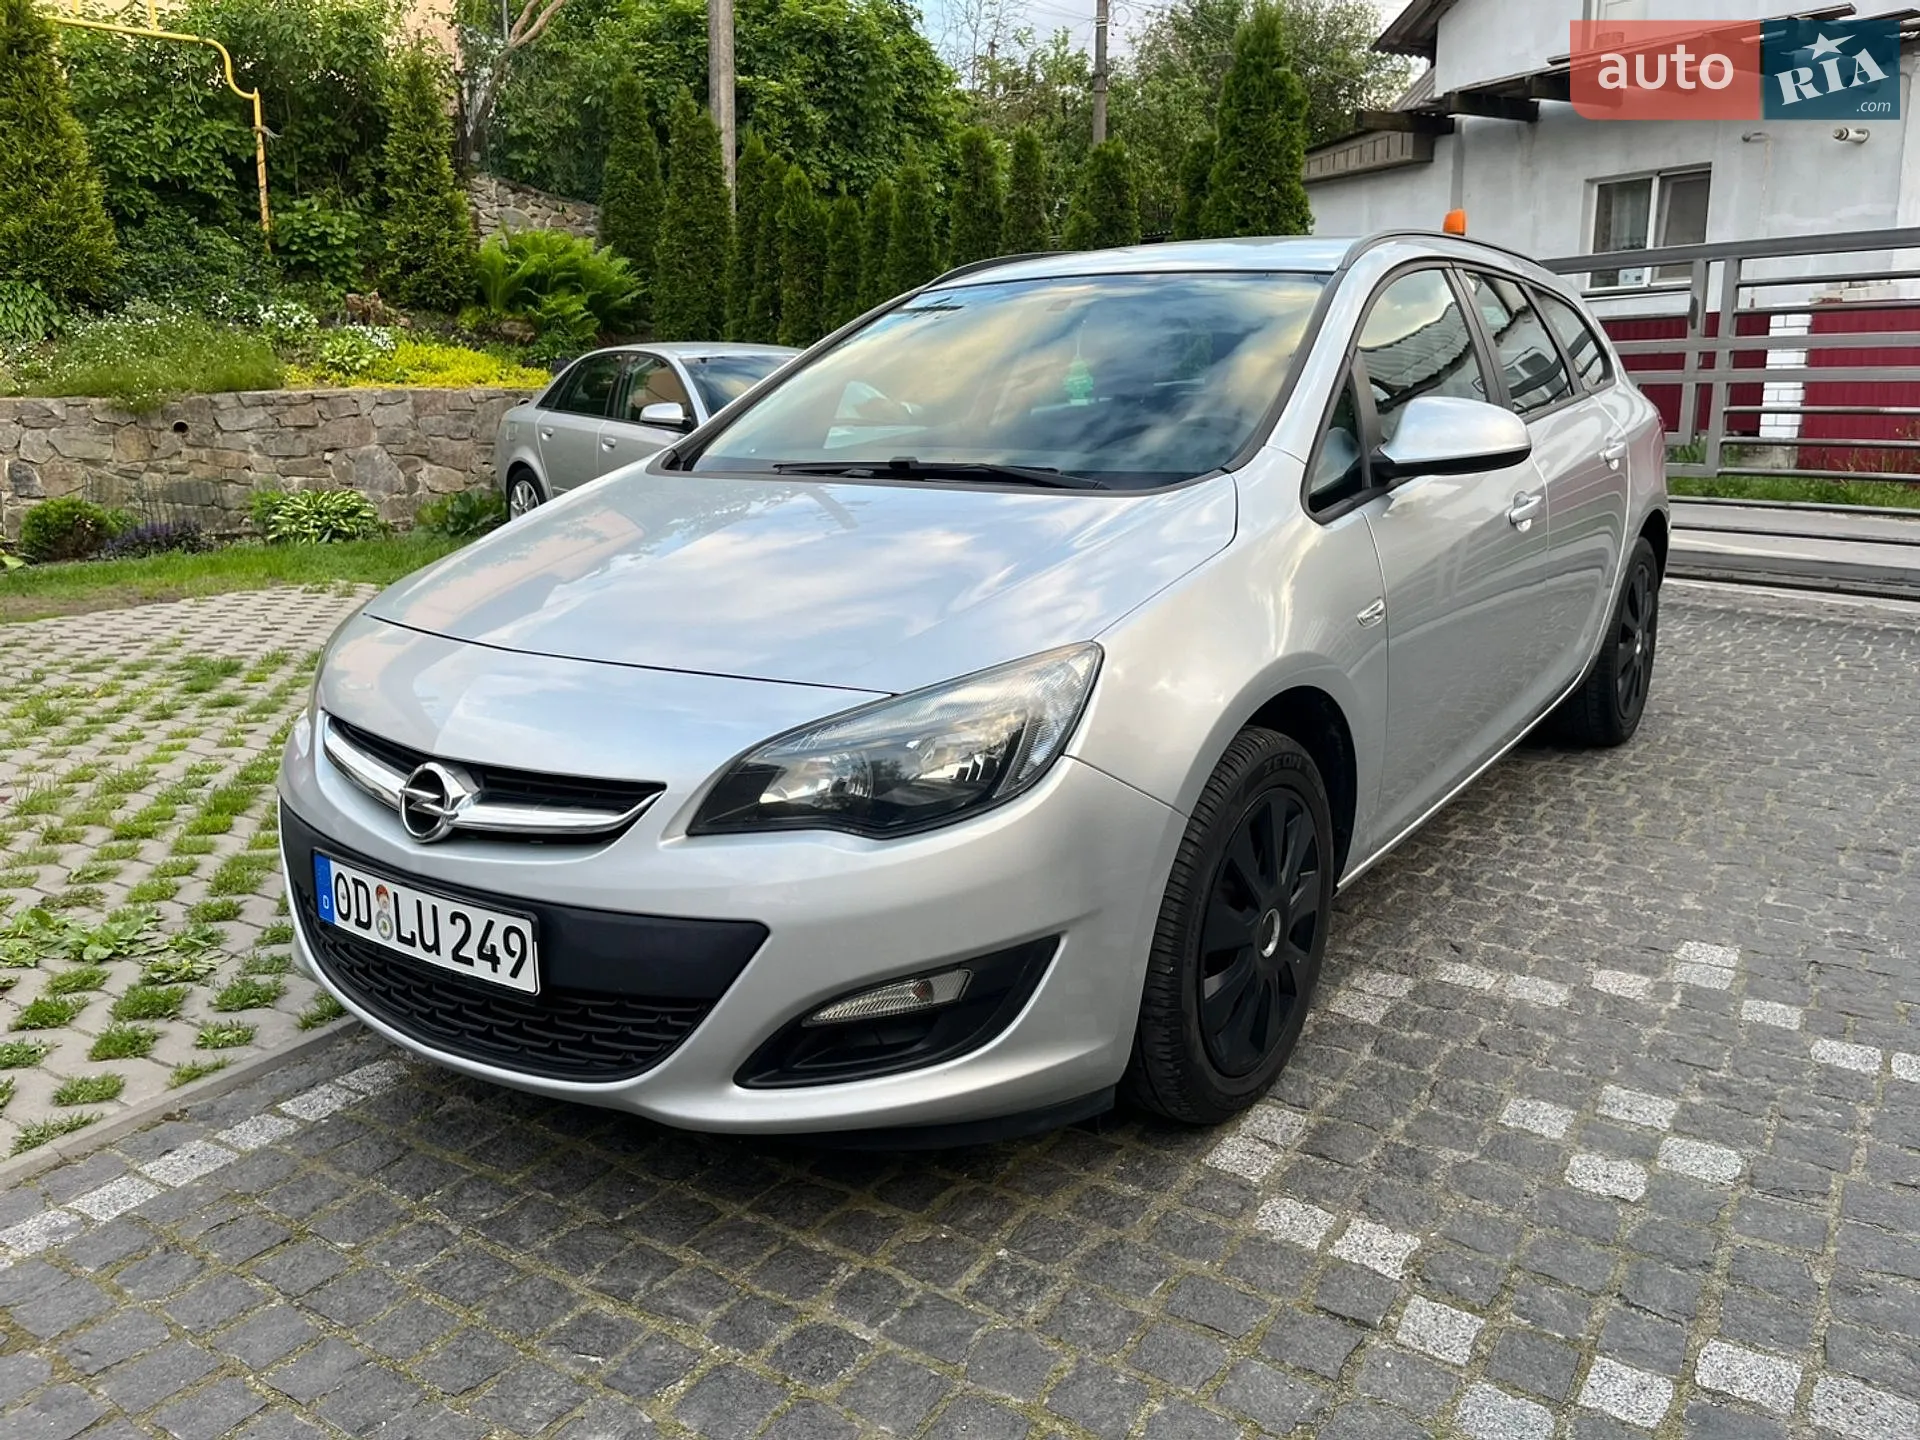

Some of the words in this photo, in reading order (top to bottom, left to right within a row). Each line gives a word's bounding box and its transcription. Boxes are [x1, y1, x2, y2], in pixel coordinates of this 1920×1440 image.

[334, 871, 372, 931] OD
[393, 891, 441, 957] LU
[450, 910, 528, 980] 249
